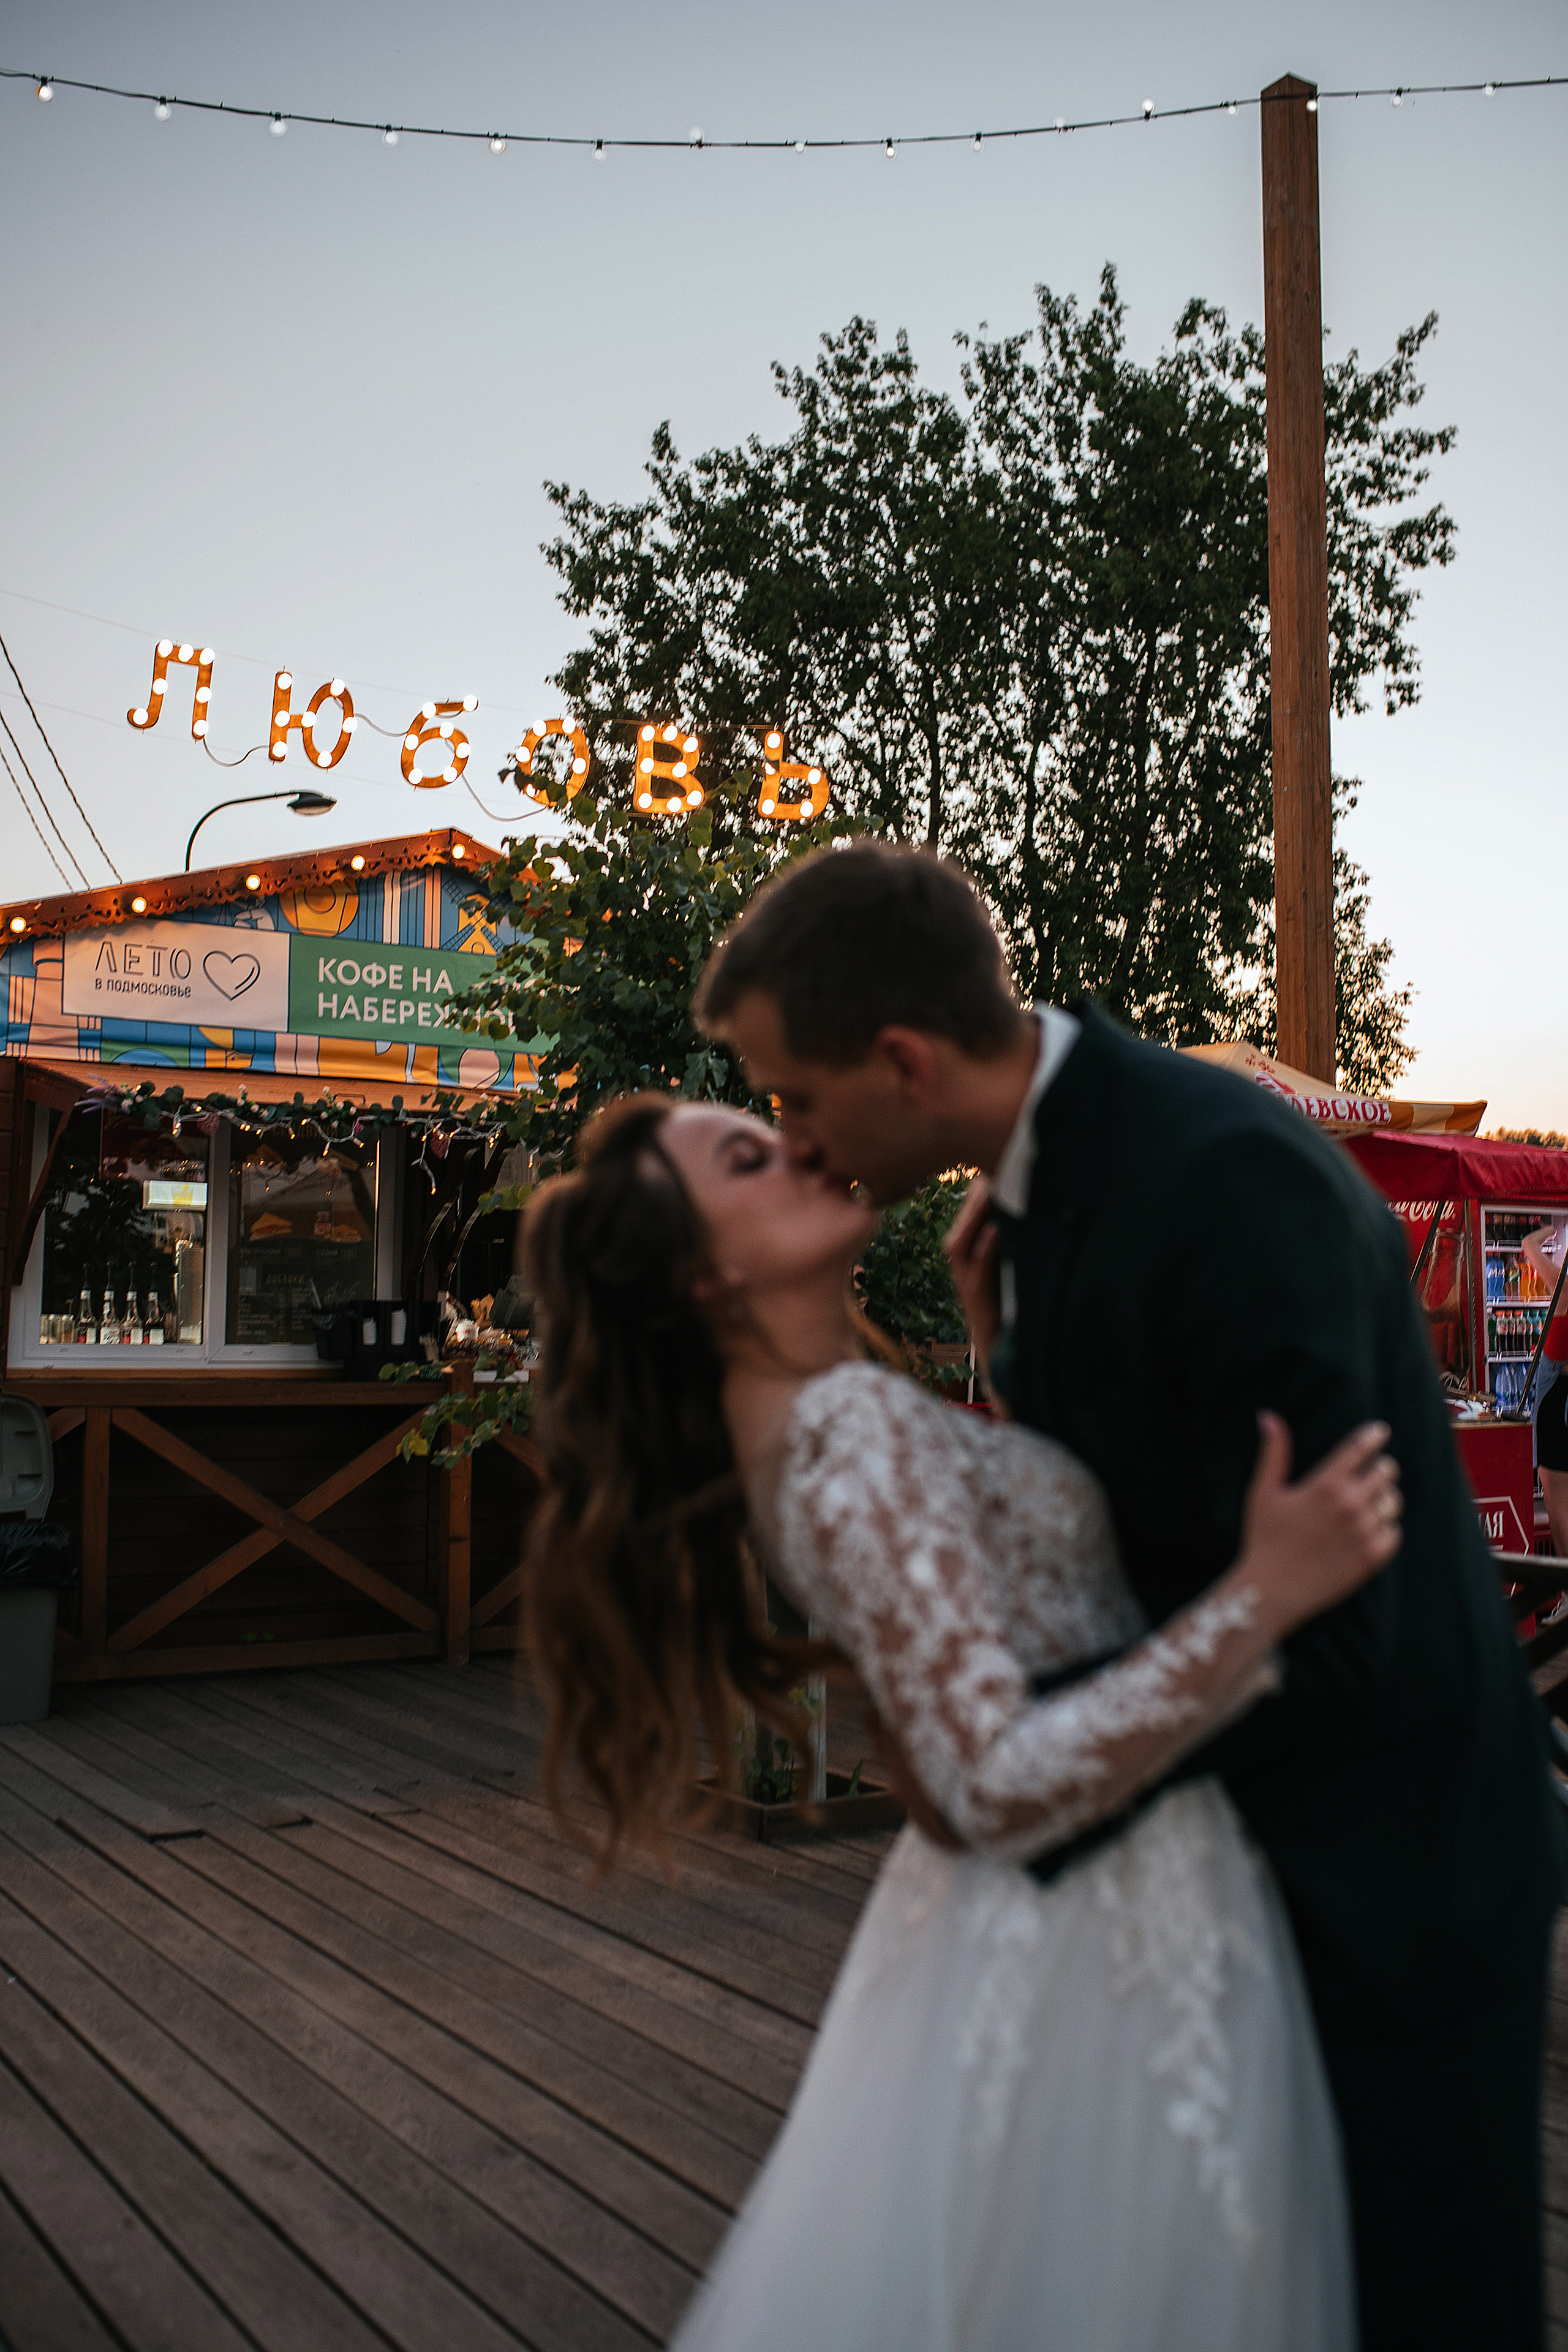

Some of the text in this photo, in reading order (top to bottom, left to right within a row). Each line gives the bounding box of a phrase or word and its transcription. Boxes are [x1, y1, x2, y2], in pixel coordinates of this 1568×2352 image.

[94, 941, 192, 980] ЛЕТО
[318, 957, 454, 995] КОФЕ НА
[318, 992, 516, 1035] НАБЕРЕЖНО
